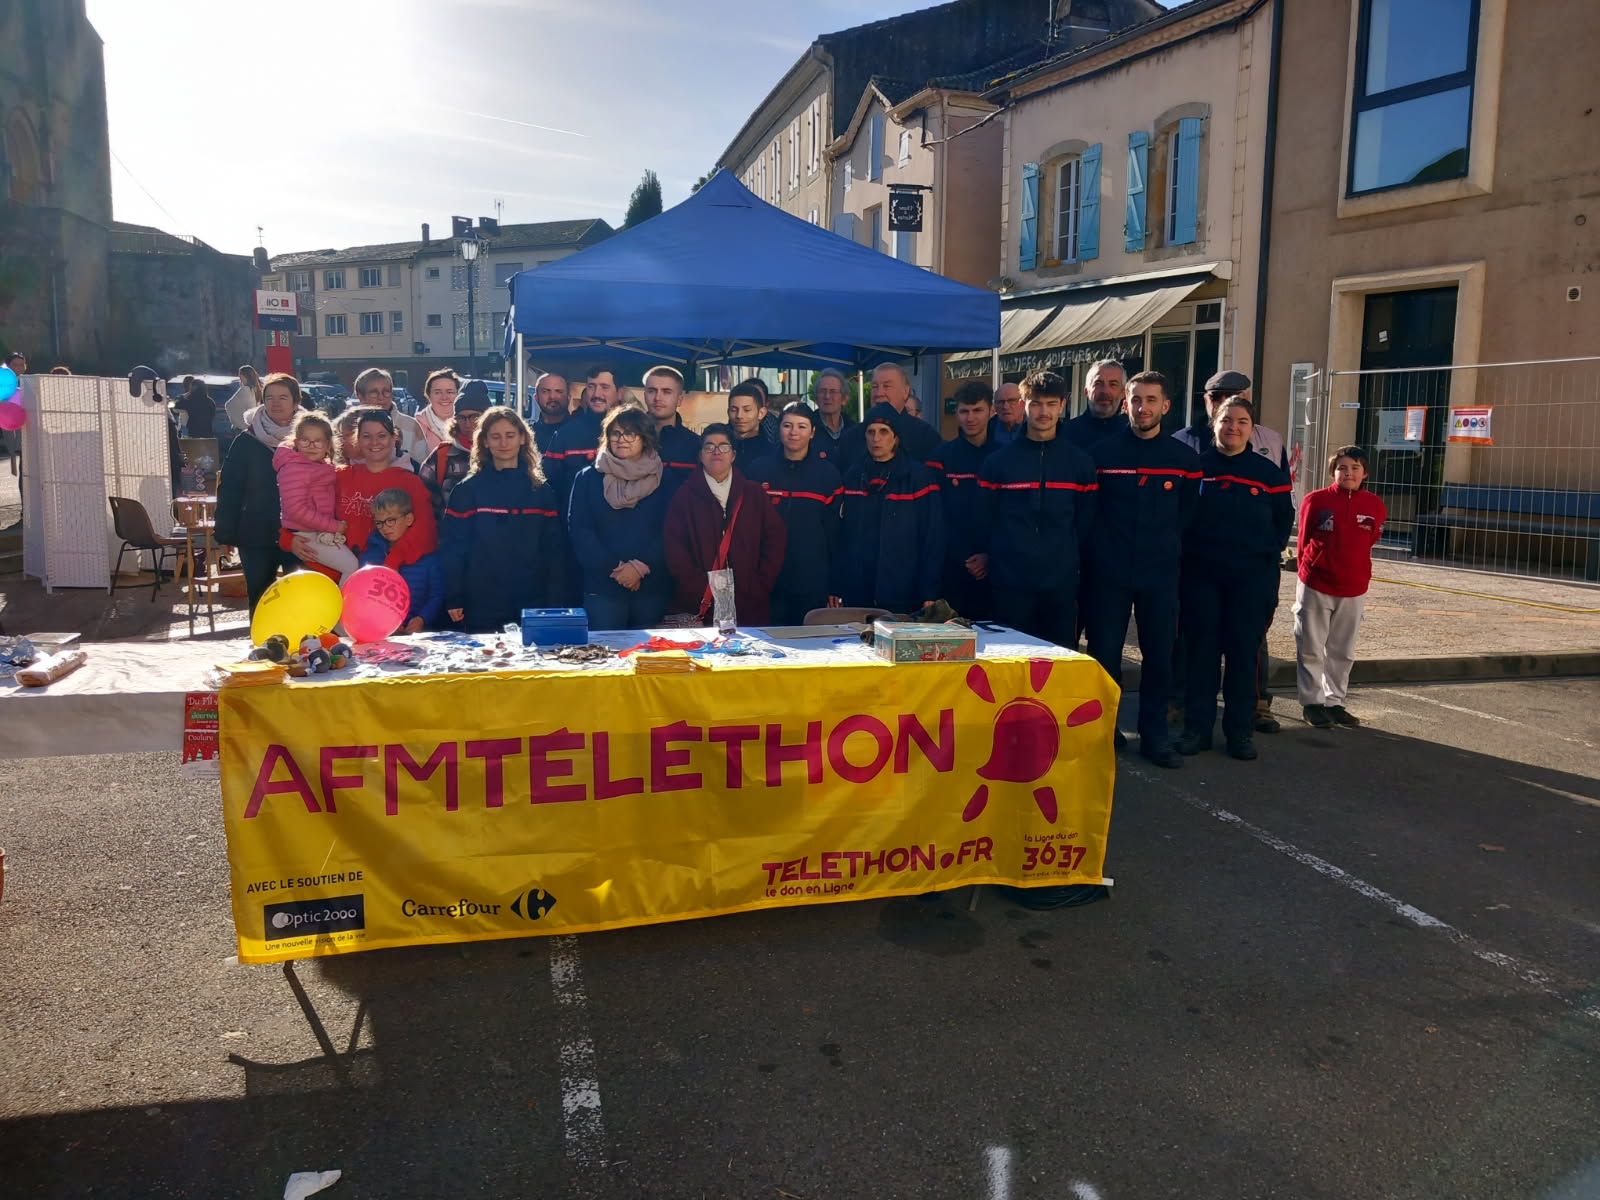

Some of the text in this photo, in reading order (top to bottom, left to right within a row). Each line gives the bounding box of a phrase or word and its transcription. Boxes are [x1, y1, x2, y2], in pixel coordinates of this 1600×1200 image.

[1055, 832, 1067, 840] du
[762, 836, 994, 886] TELETHON.FR
[1021, 841, 1088, 871] 3637
[246, 871, 363, 894] AVEC LE SOUTIEN DE
[765, 886, 777, 898] le
[780, 884, 803, 896] don
[806, 884, 821, 894] en
[401, 898, 501, 917] Carrefour
[279, 908, 357, 928] Optic 2000
[265, 942, 281, 951] Une
[281, 938, 313, 948] nouvelle
[315, 937, 336, 945] vision
[337, 934, 346, 942] de
[347, 932, 354, 940] la
